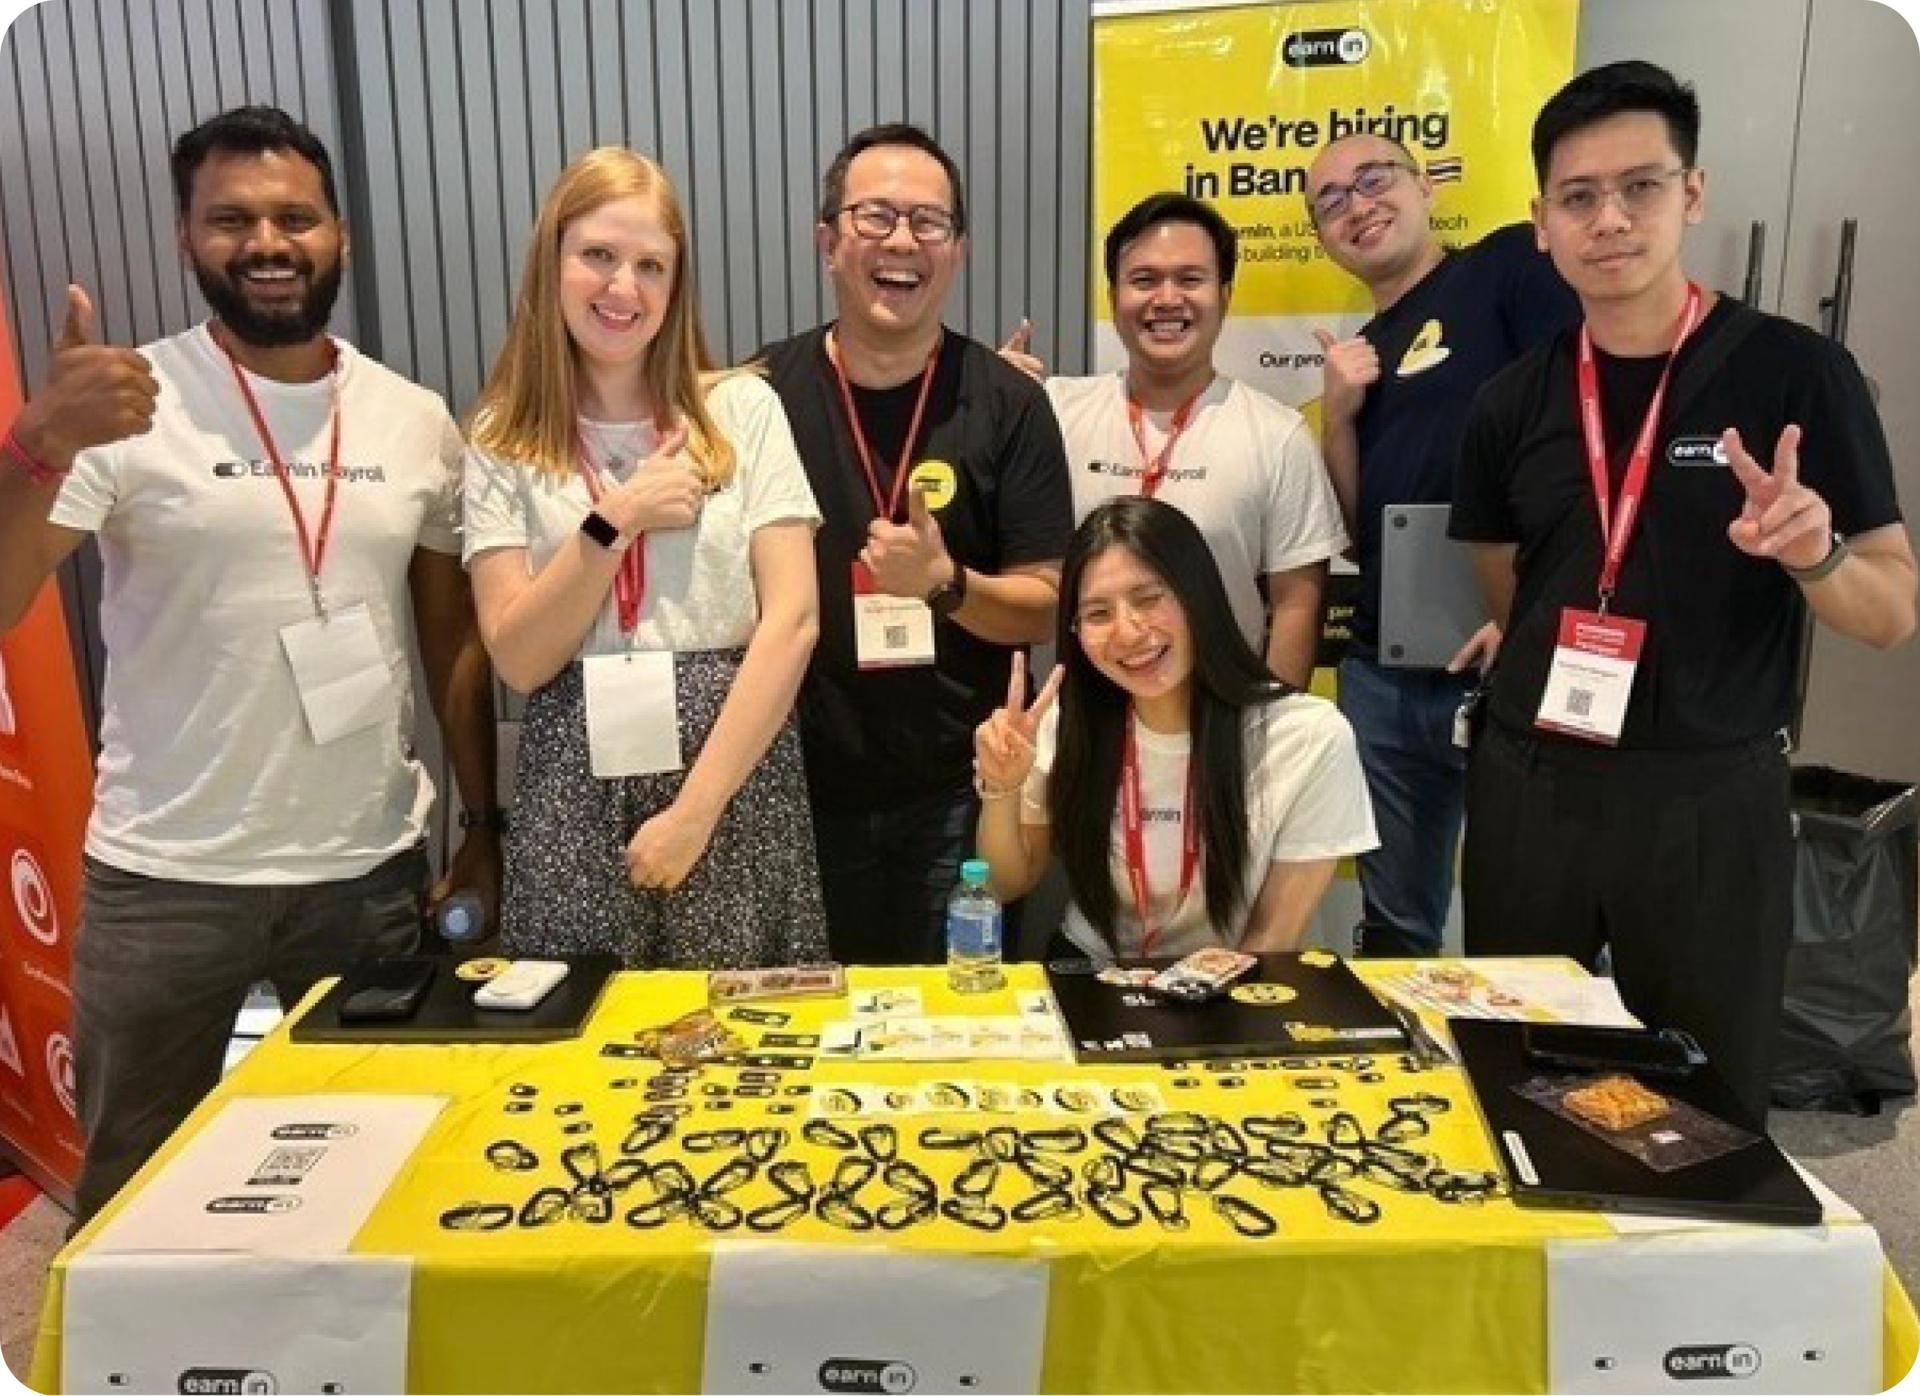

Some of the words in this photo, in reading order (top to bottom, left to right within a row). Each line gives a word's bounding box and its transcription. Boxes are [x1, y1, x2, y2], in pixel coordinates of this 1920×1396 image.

[1201, 115, 1318, 153] We're
[1329, 105, 1449, 150] hiring
[1185, 162, 1219, 200] in
[1230, 163, 1307, 196] Ban
[1243, 243, 1310, 265] building
[1294, 353, 1325, 371] pro
[1671, 1354, 1723, 1371] earn
[825, 1368, 879, 1384] earn
[183, 1378, 243, 1394] earn
